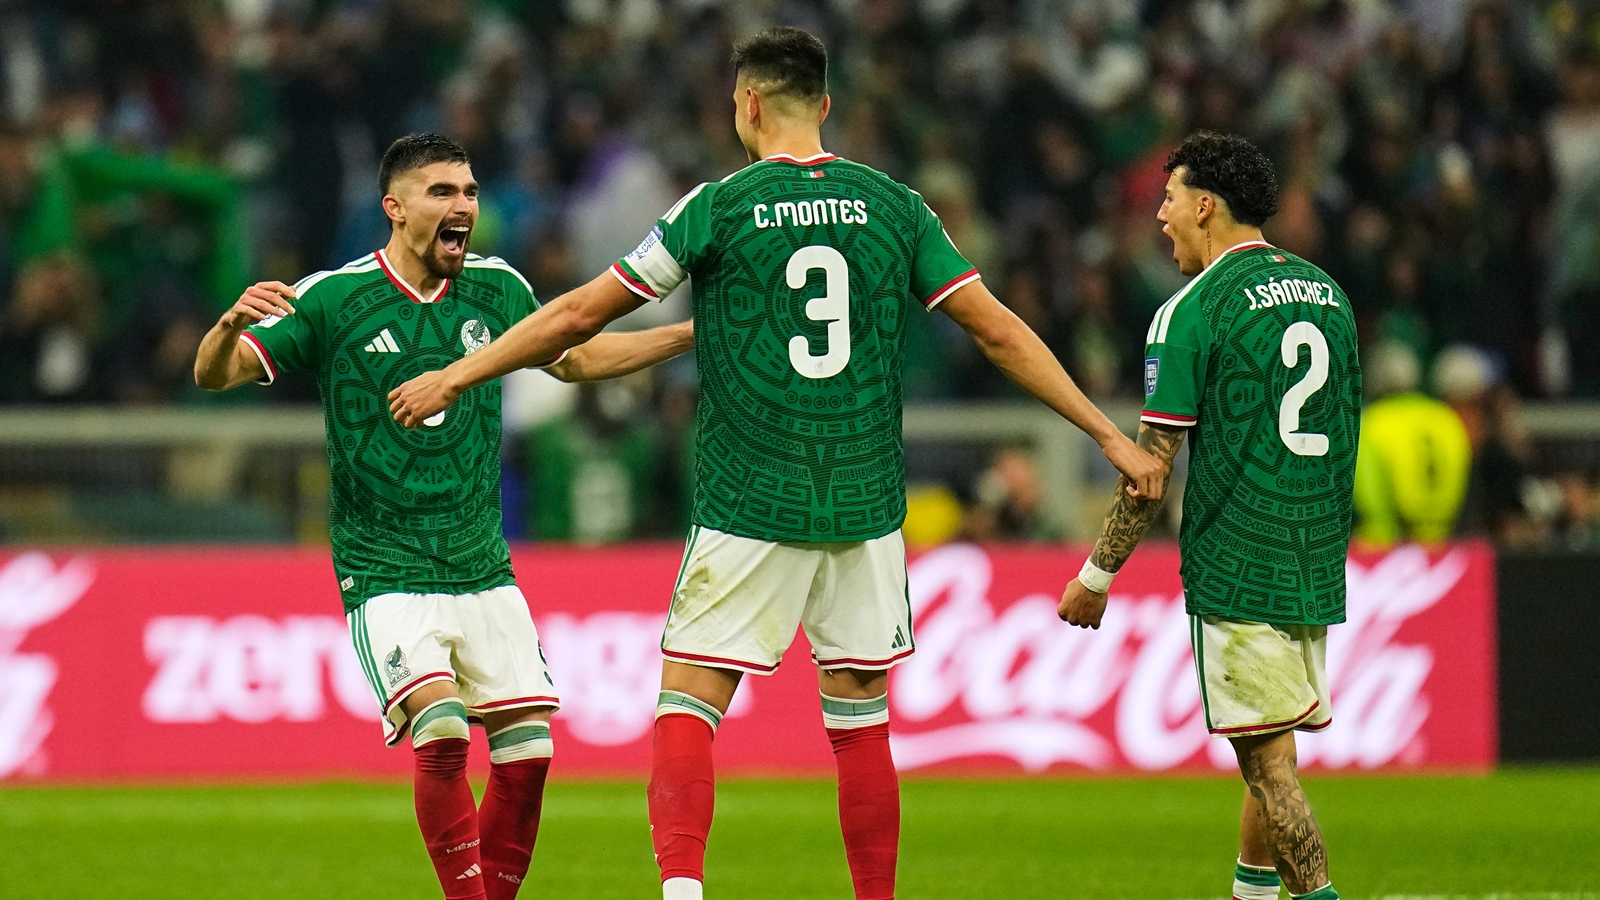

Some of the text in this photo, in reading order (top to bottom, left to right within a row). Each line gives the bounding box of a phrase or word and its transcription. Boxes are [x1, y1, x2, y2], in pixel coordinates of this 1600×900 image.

[753, 198, 868, 229] C.MONTES
[1243, 276, 1340, 311] J.SÁNCHEZ
[786, 245, 850, 379] 3
[1278, 320, 1330, 457] 2
[886, 543, 1468, 771] Coca-Cla
[1294, 832, 1318, 864] HAPPY
[1295, 821, 1307, 842] MY
[1299, 848, 1323, 880] PLACE
